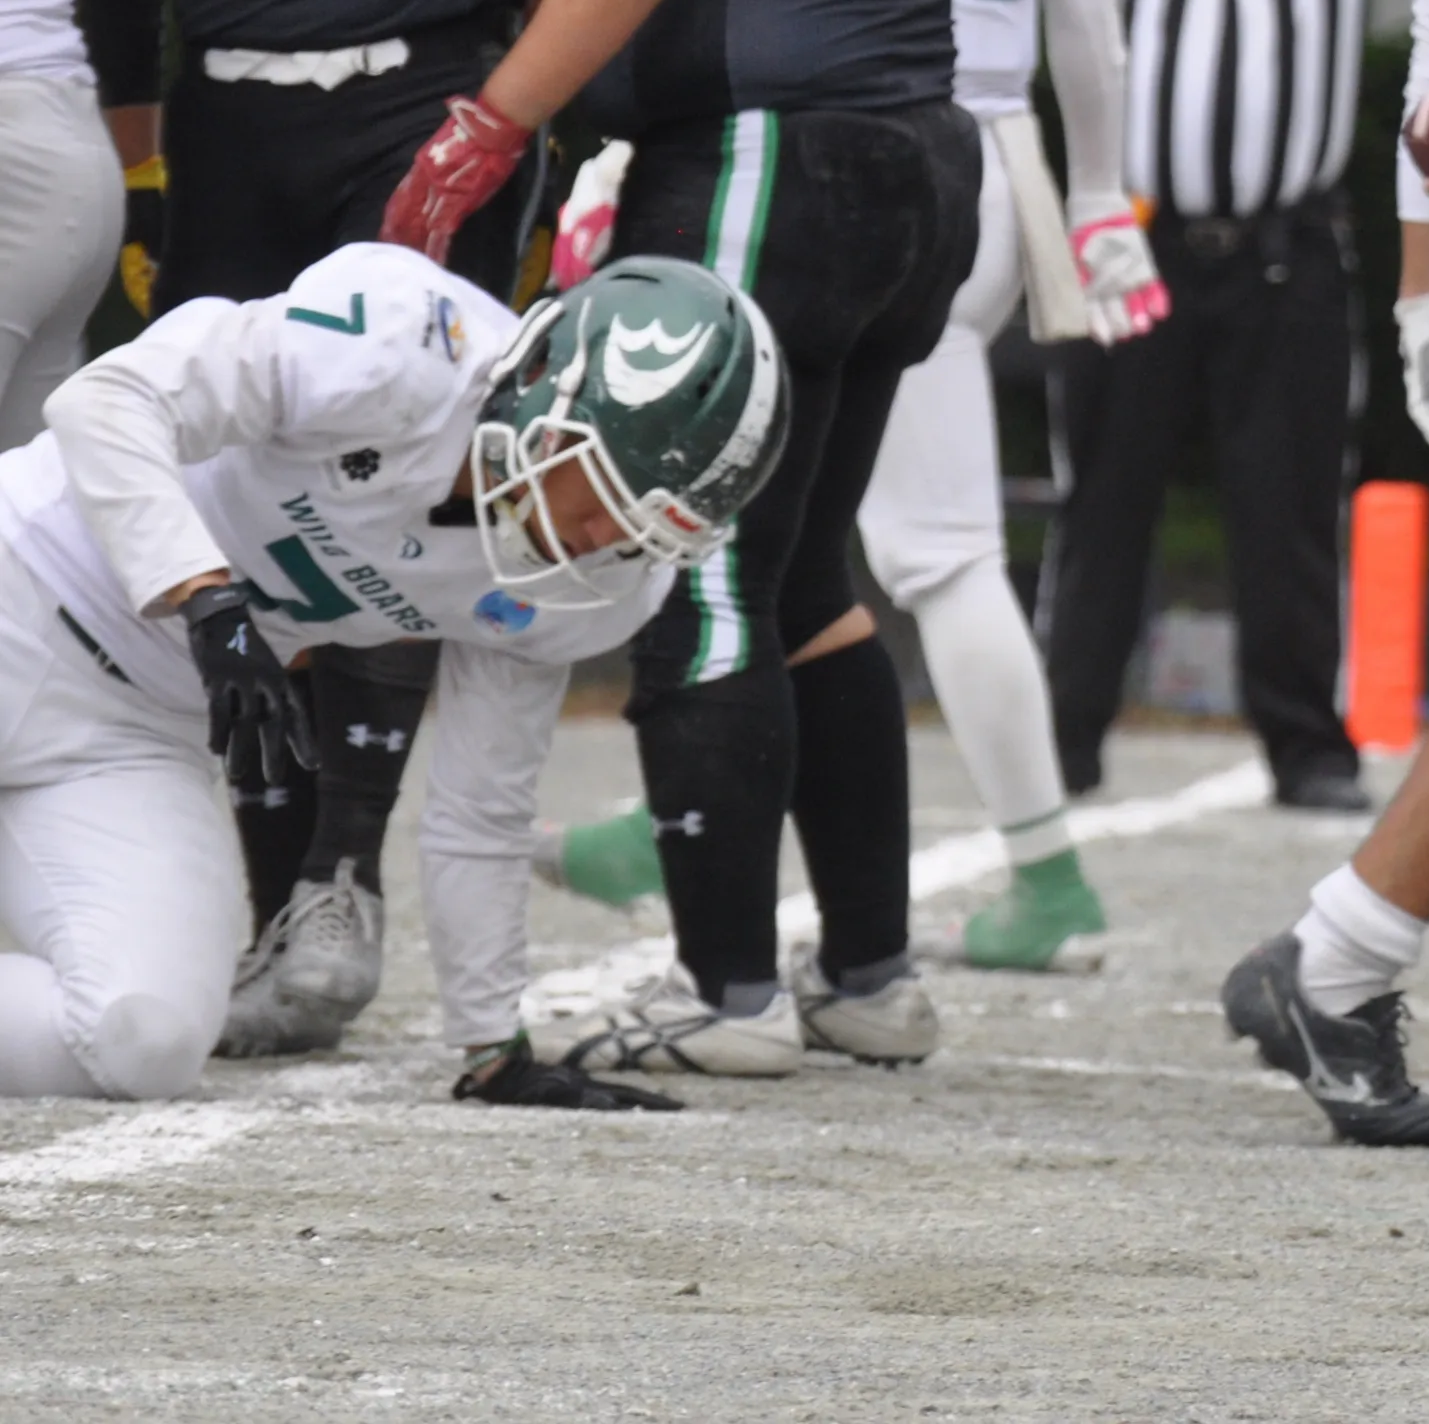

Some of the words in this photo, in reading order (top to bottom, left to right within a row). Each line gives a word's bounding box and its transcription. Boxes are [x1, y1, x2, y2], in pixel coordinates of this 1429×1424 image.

[284, 292, 366, 336] 7
[245, 533, 362, 624] 7
[341, 564, 436, 633] BOARS
